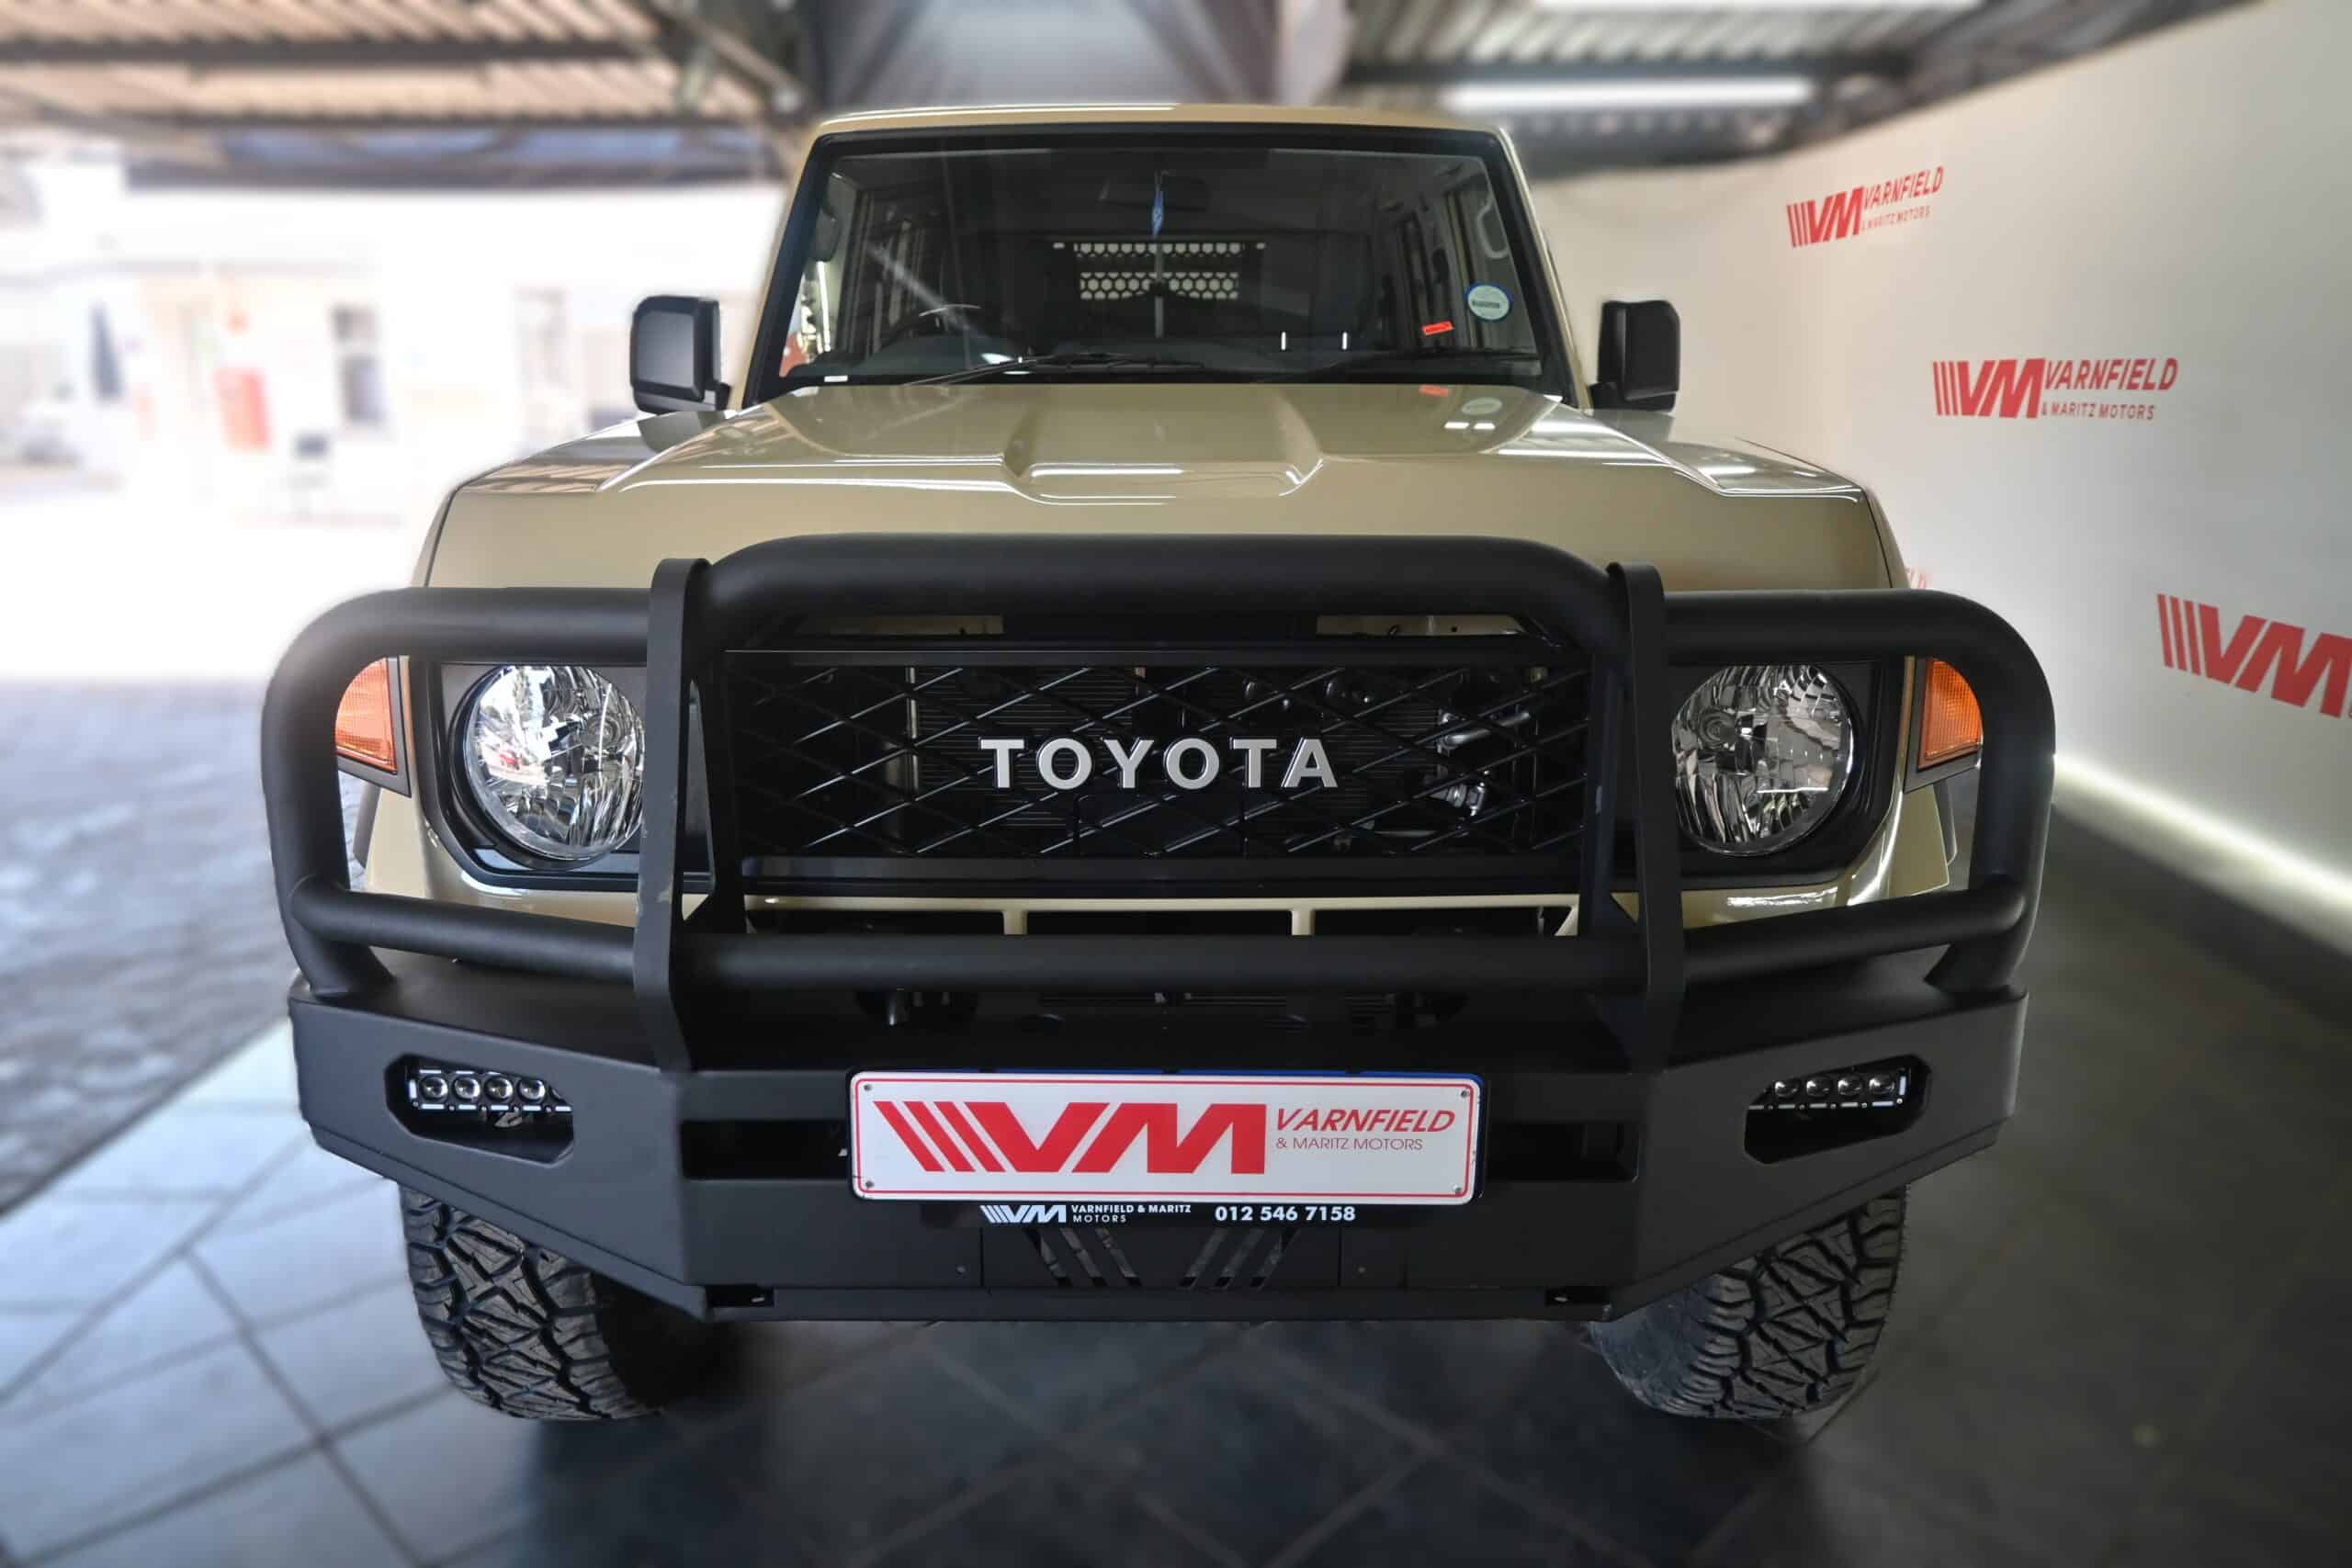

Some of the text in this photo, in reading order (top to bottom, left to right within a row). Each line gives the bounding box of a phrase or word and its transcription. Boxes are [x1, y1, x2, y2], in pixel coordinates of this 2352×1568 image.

[1864, 166, 1944, 210] VARNFIELD
[2044, 357, 2178, 390] VARNFIELD
[2050, 401, 2095, 418] MARITZ
[2098, 403, 2155, 420] MOTORS
[978, 737, 1338, 790] TOYOTA
[1277, 1108, 1455, 1133] VARNFIELD
[1276, 1137, 1423, 1151] & MARITZ MOTORS
[1071, 1204, 1192, 1213] VARNFIELD & MARITZ
[1215, 1206, 1356, 1222] 012 546 7158
[1073, 1214, 1126, 1223] MOTORS
